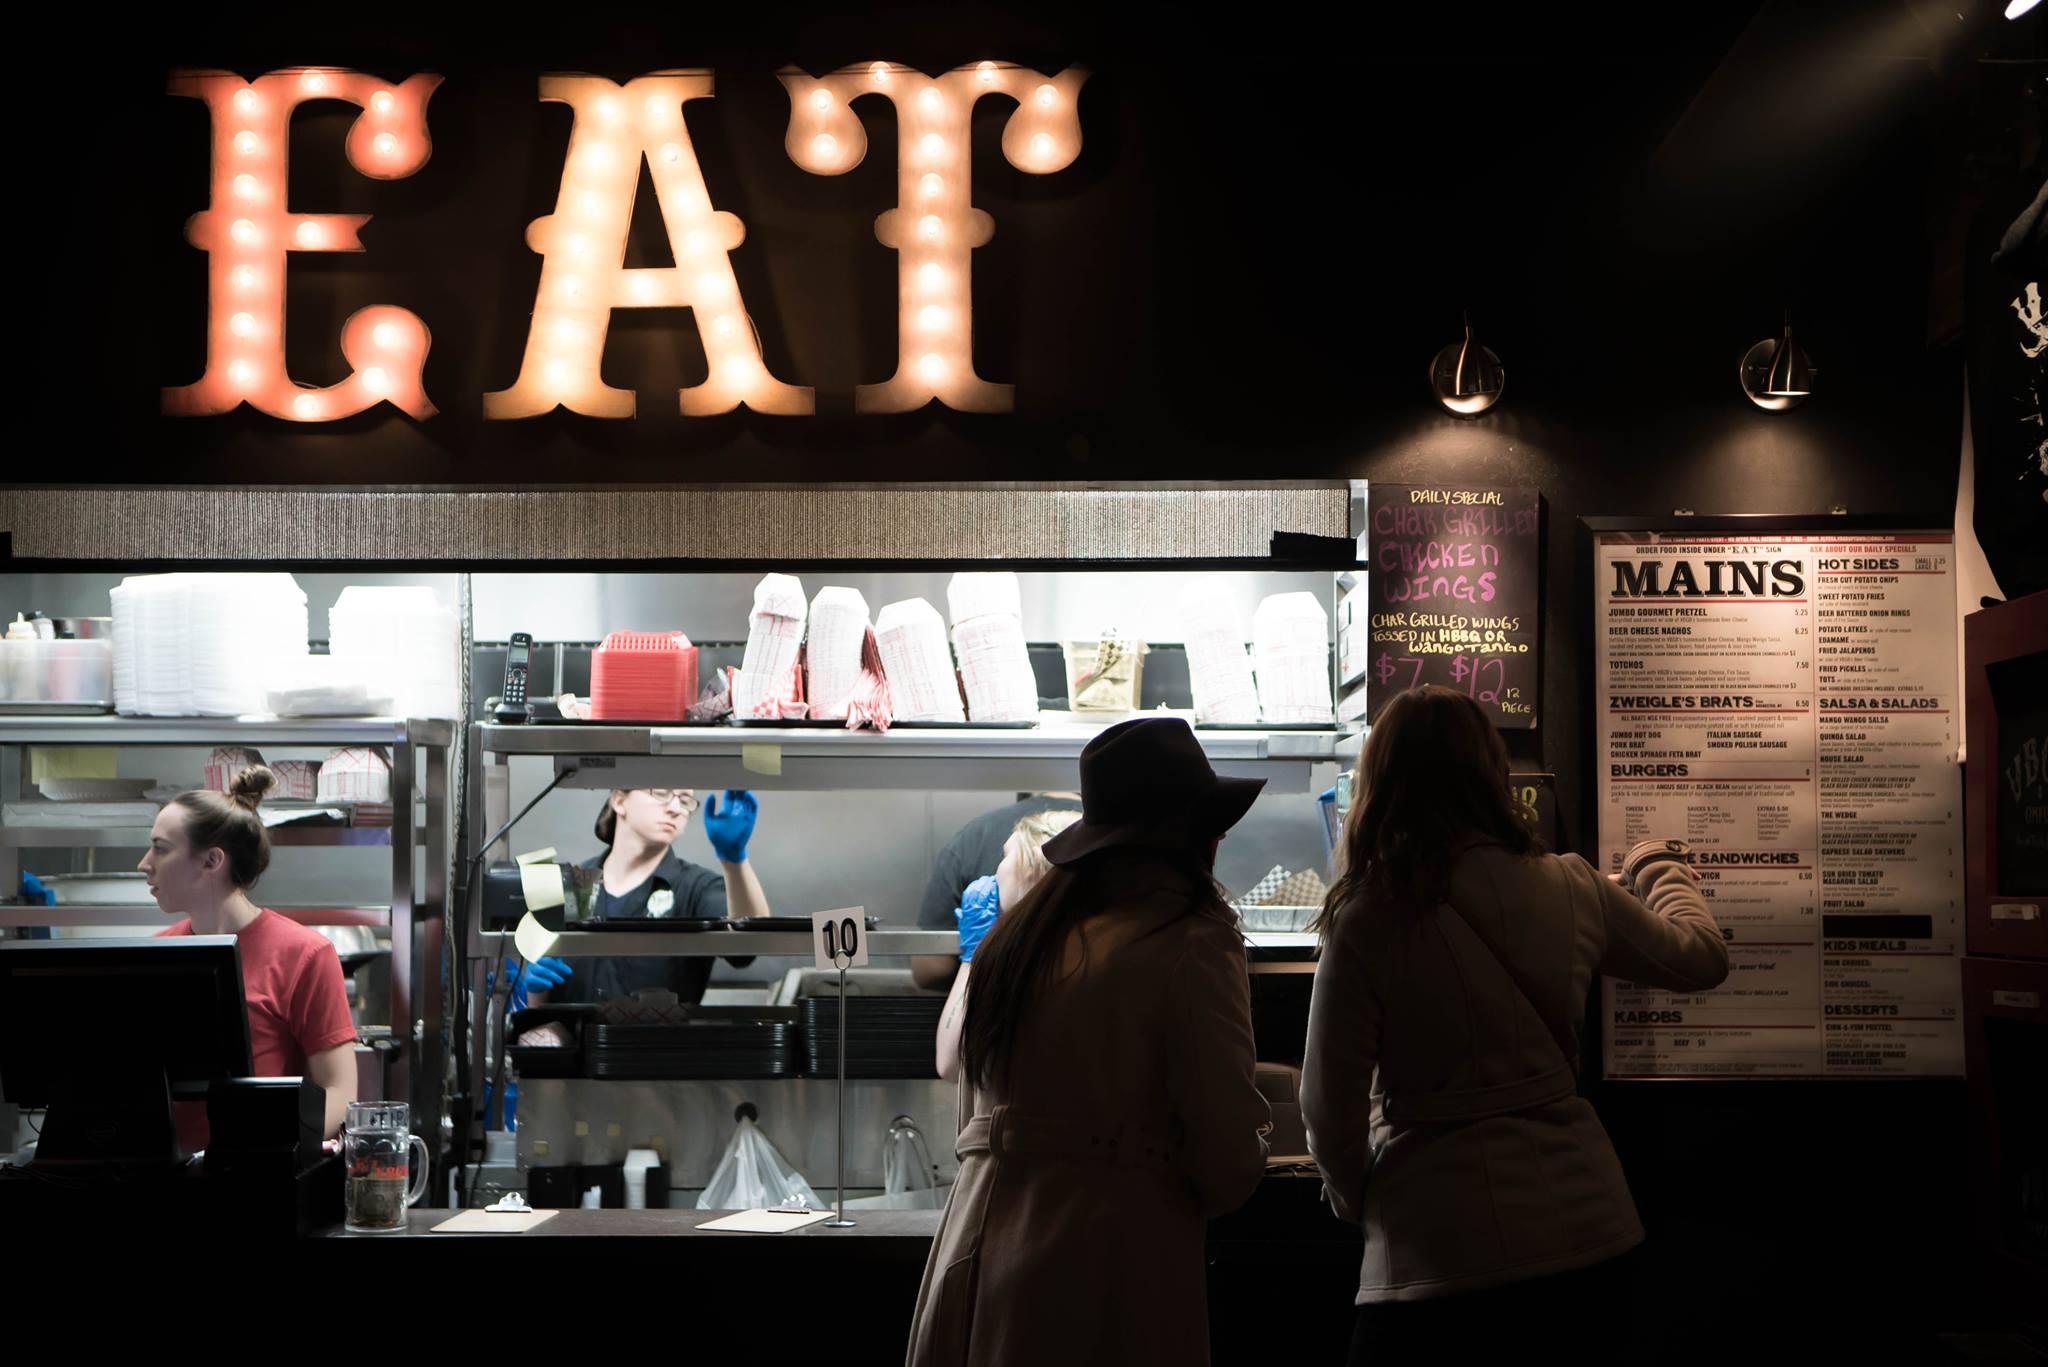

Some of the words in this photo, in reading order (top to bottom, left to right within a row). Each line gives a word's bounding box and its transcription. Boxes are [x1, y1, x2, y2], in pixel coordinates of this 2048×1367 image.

[160, 60, 1093, 422] EAT
[1411, 490, 1449, 504] DAILY
[1451, 491, 1504, 505] SPECIAL
[1818, 559, 1849, 569] HOT
[1853, 559, 1899, 569] SIDES
[1611, 561, 1806, 597] MAINS
[1608, 608, 1635, 616] JUMBO
[1638, 608, 1673, 616] GOURMET
[1676, 608, 1708, 616] PRETZEL
[1372, 612, 1407, 628] CHAR
[1409, 612, 1467, 629] GRILLED
[1472, 617, 1520, 631] WINGS
[1421, 630, 1435, 642] IN
[1485, 630, 1506, 642] OR
[1609, 627, 1628, 635] BEER
[1631, 627, 1659, 635] CHEESE
[1662, 627, 1692, 635] NACHOS
[1610, 661, 1644, 669] TOTCHOS
[1375, 652, 1424, 692] $7
[1507, 688, 1520, 698] 12
[1502, 702, 1531, 713] PIECE
[1610, 696, 1695, 708] ZWEIGLE'S
[1701, 696, 1753, 708] BRATS
[1820, 698, 1867, 708] SALSA
[1869, 698, 1880, 708] &
[1881, 698, 1938, 708] SALADS
[1611, 764, 1688, 776] BURGERS
[1700, 853, 1799, 864] SANDWICHES
[823, 918, 858, 959] 10
[1824, 941, 1857, 950] KIDS
[1859, 941, 1906, 950] MEALS
[1824, 1005, 1899, 1015] DESSERTS
[1615, 1011, 1683, 1023] KABOBS
